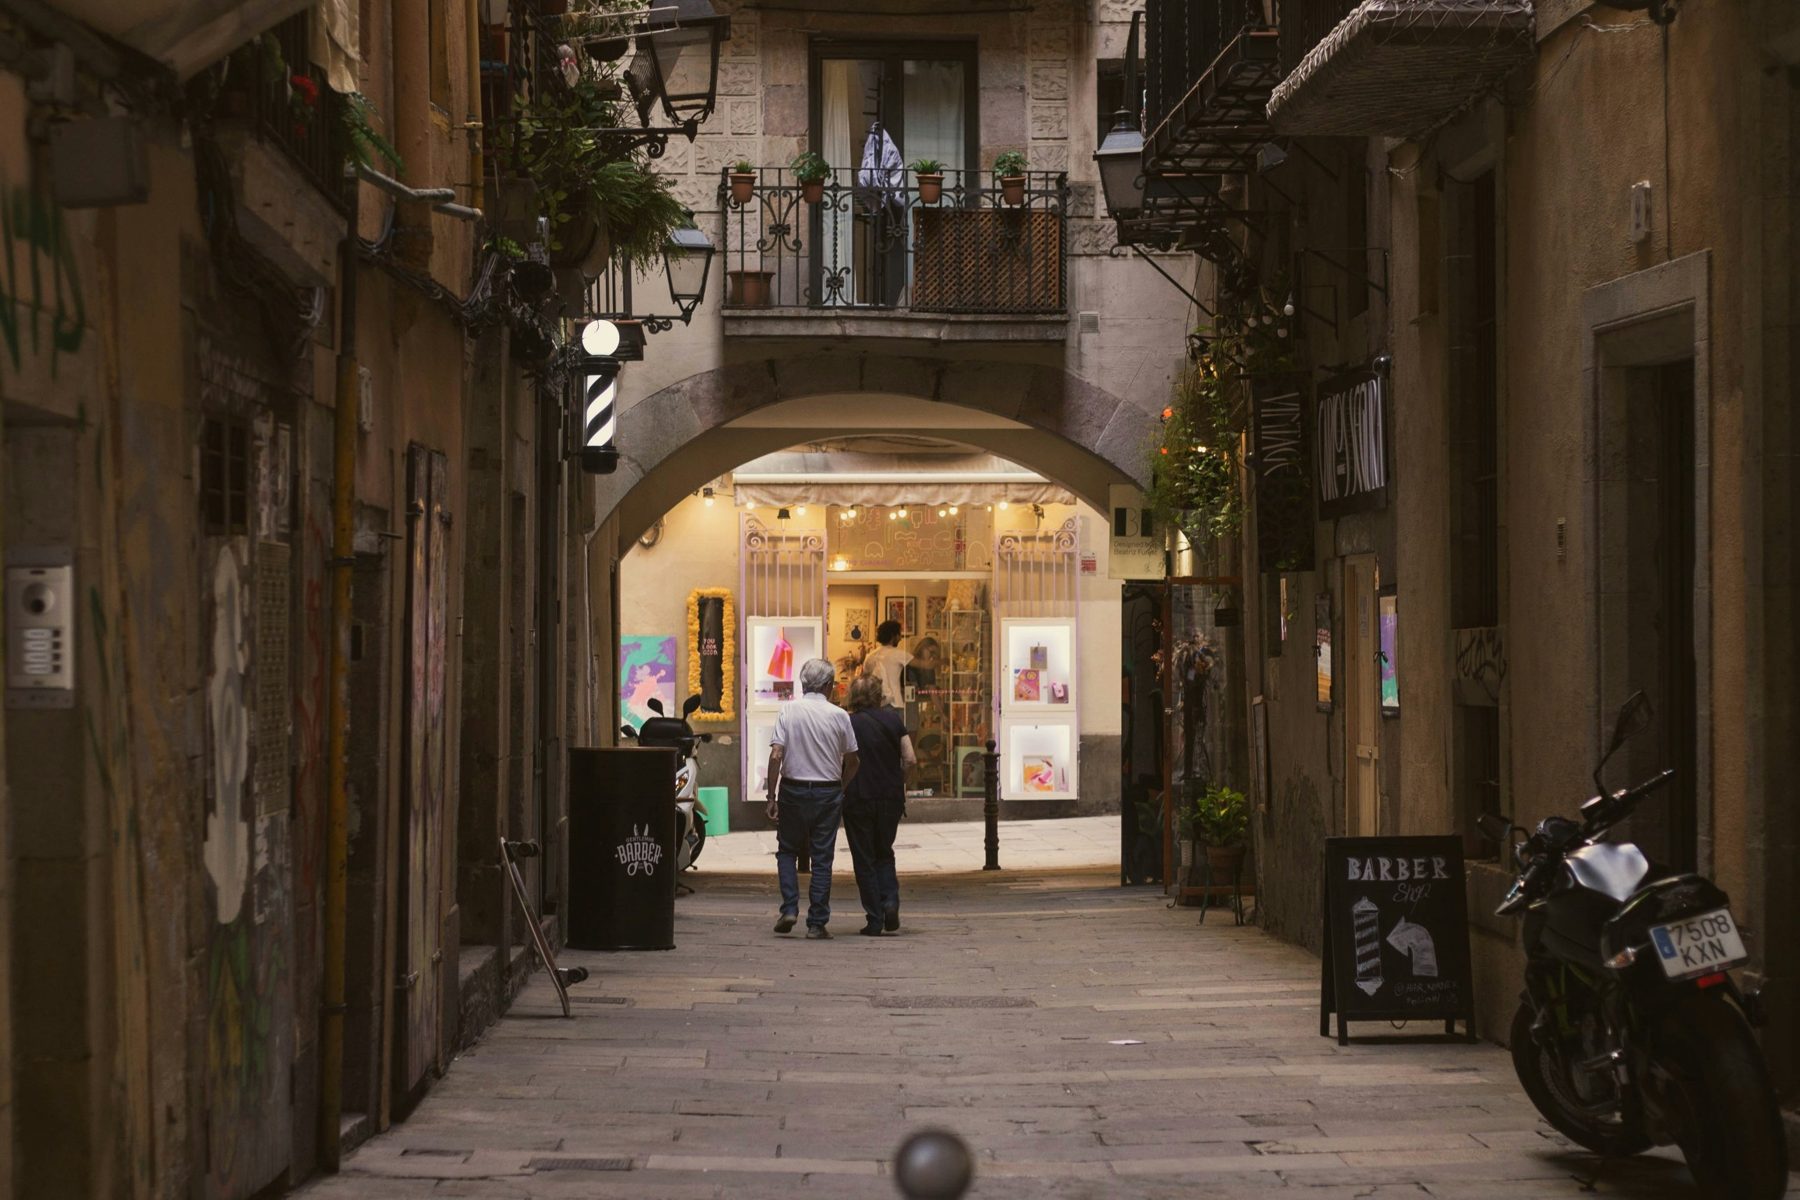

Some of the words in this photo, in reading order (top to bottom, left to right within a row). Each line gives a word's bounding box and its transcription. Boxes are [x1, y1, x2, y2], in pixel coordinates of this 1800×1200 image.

[617, 842, 661, 865] BARBER
[1346, 857, 1449, 881] BARBER
[1392, 882, 1432, 914] Shop
[1668, 914, 1731, 946] 7508
[1680, 938, 1727, 968] KXN
